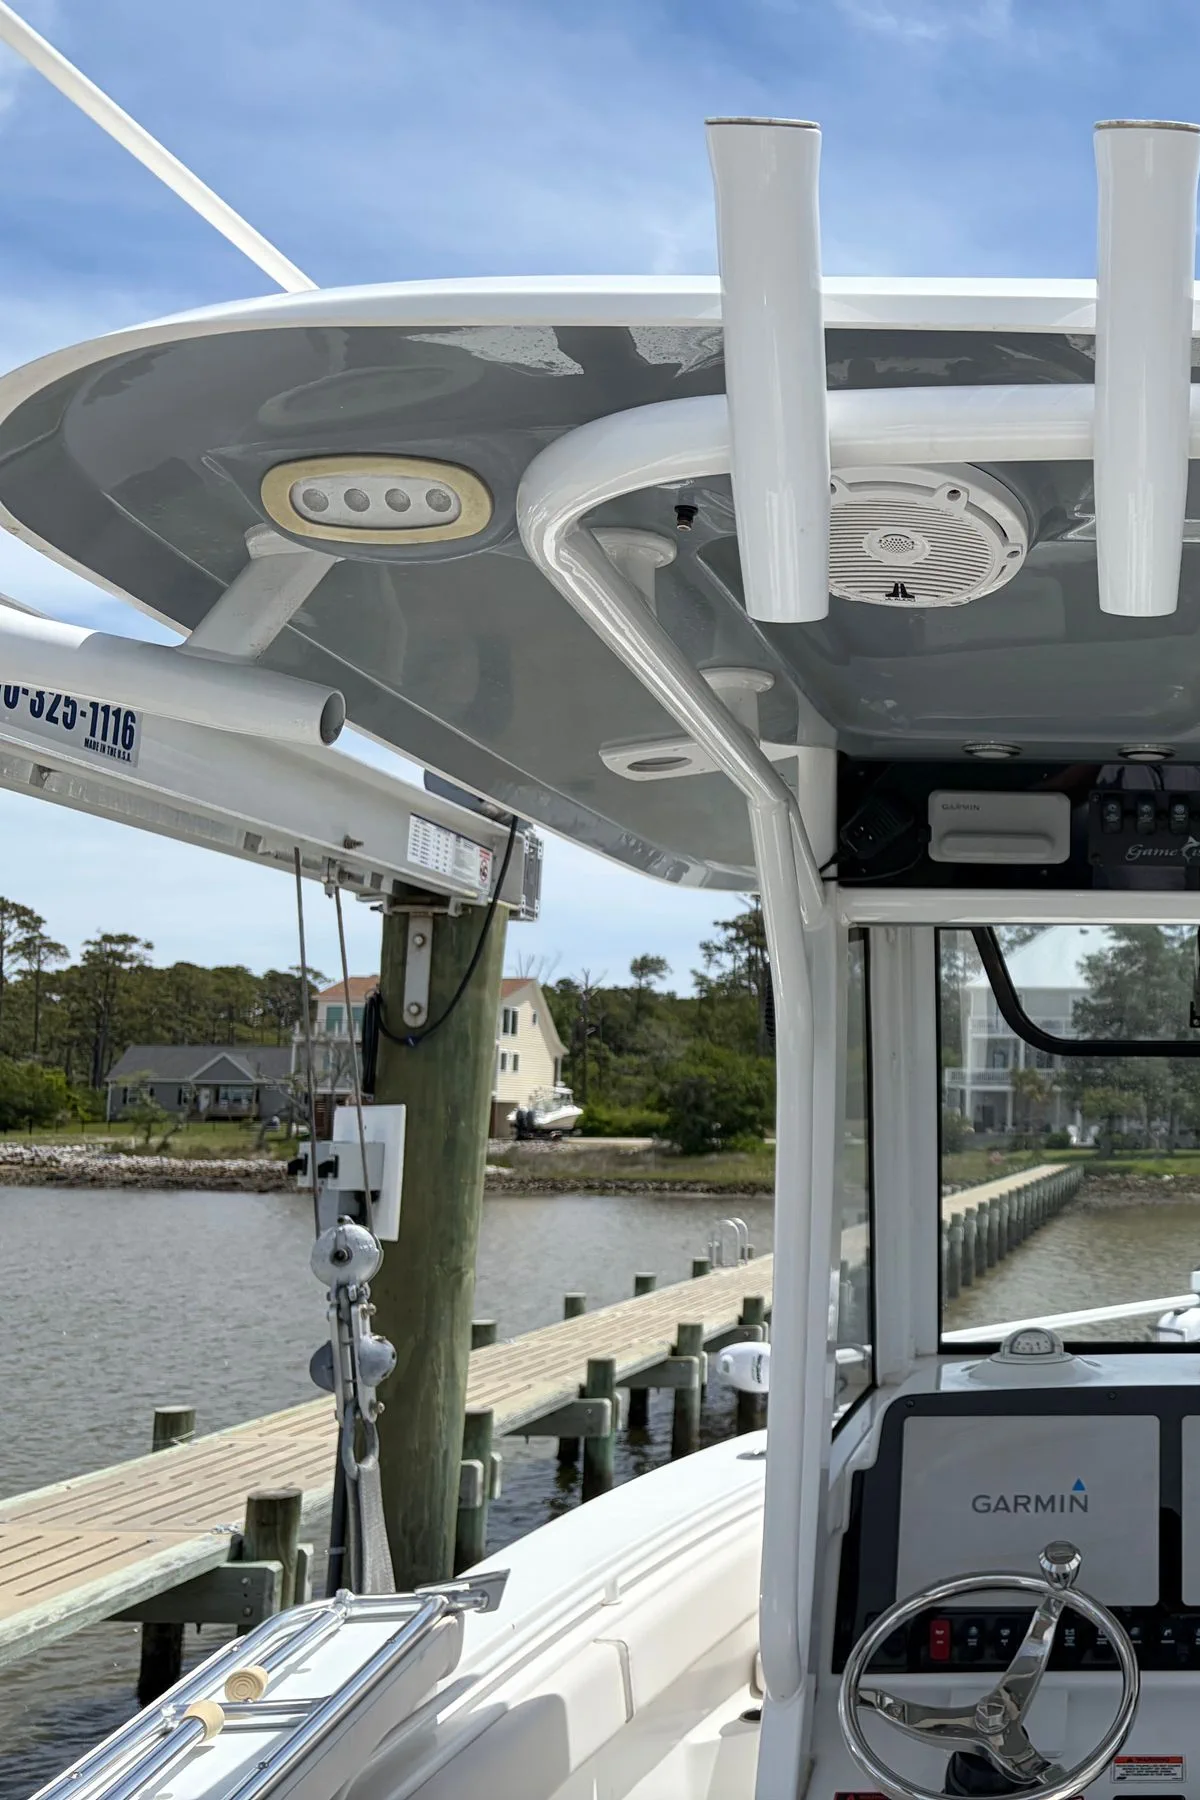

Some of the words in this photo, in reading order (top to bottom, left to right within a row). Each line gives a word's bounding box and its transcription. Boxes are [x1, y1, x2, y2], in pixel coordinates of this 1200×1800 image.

[84, 737, 100, 753] MADE
[107, 745, 118, 758] THE
[941, 803, 981, 811] GARMIN
[1125, 843, 1178, 862] Game
[971, 1493, 1089, 1515] GARMIN
